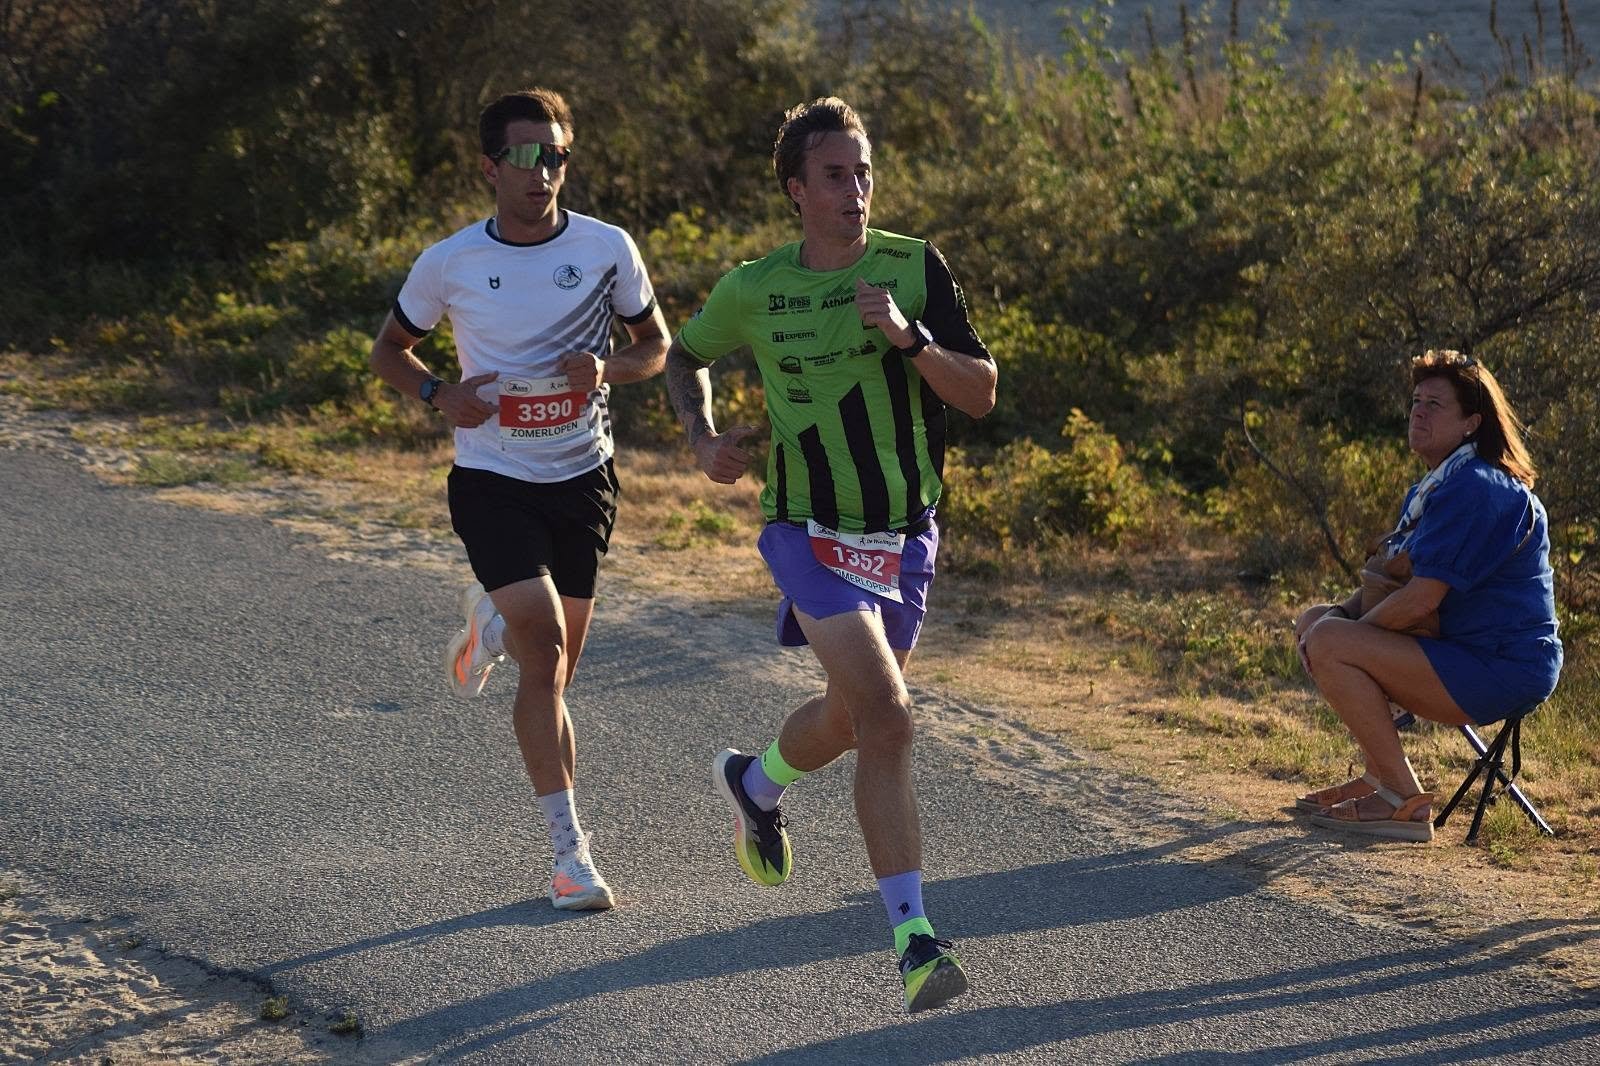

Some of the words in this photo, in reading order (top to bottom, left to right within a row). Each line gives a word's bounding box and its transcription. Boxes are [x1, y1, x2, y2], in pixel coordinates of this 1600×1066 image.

[785, 331, 816, 340] EXPERTS
[518, 399, 572, 422] 3390
[511, 421, 578, 438] ZOMERLOPEN
[833, 546, 885, 577] 1352
